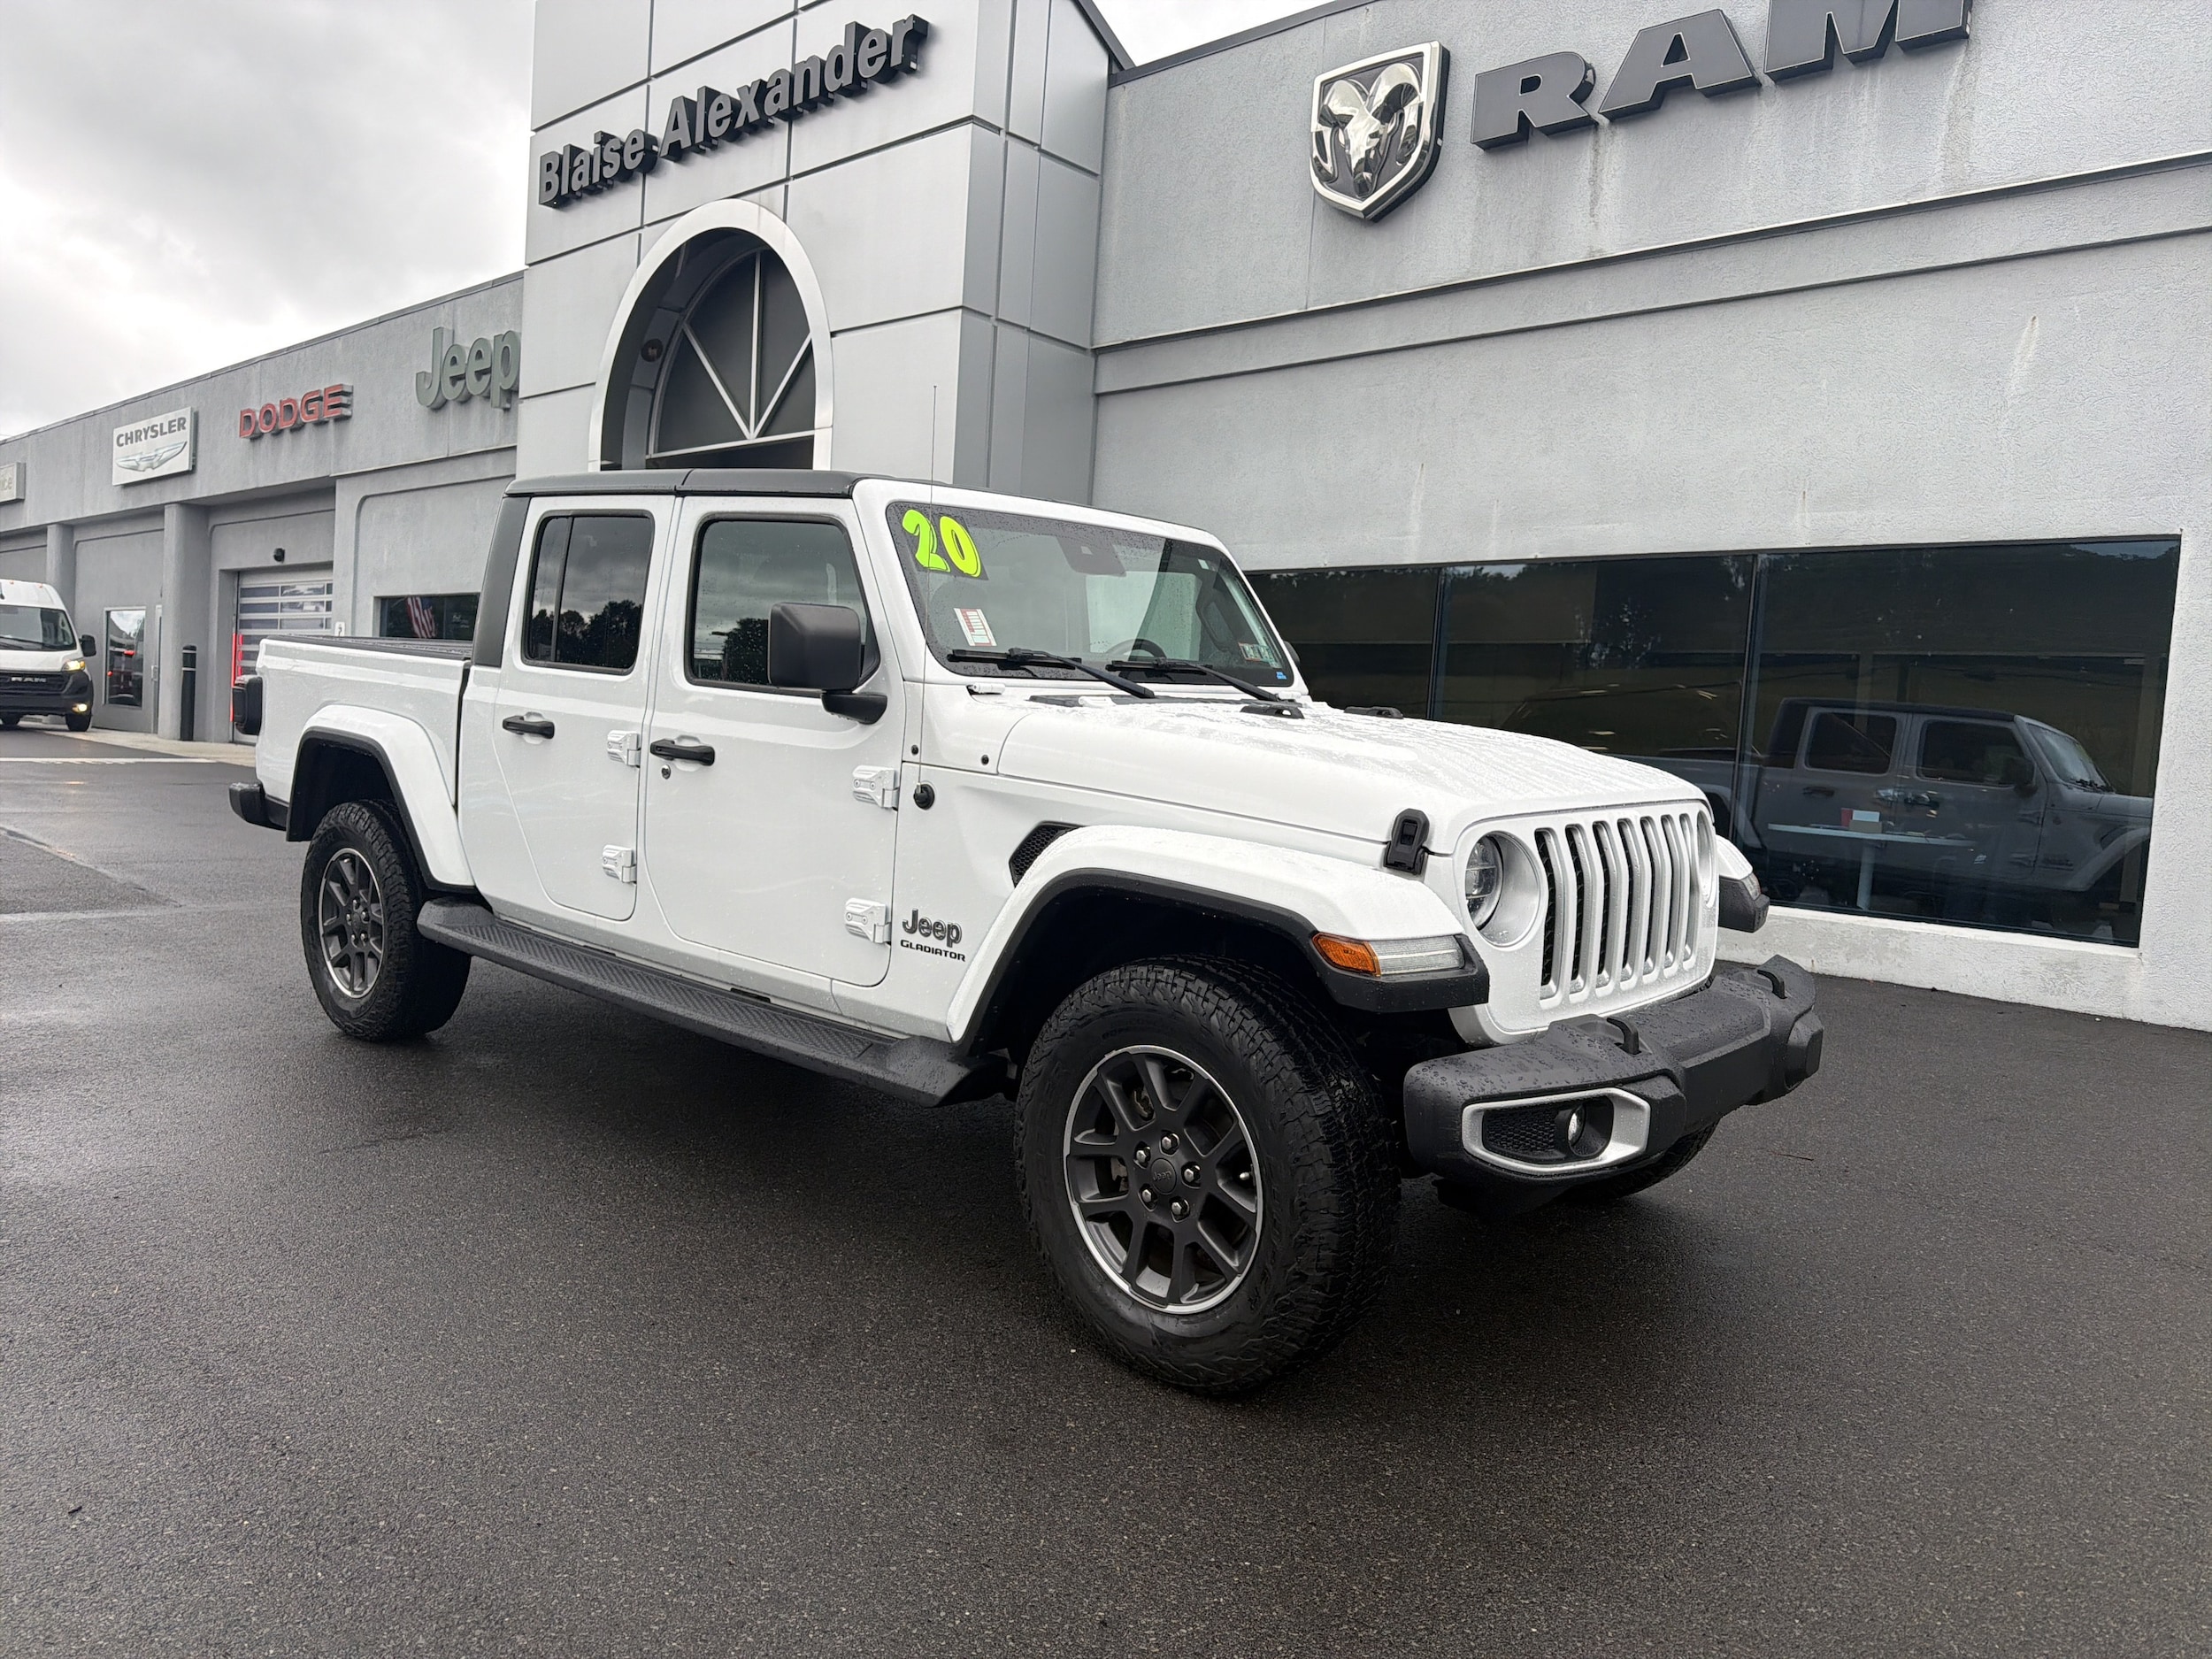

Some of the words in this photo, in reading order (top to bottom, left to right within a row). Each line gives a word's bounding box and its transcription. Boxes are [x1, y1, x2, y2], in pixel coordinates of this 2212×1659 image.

[1470, 0, 1968, 150] RAM
[539, 128, 653, 206] Blaise
[659, 13, 926, 161] Alexander
[415, 326, 520, 408] Jeep
[116, 417, 187, 447] CHRYSLER
[239, 384, 349, 438] DODGE
[902, 509, 981, 578] 20
[900, 939, 965, 962] GLADIATOR
[902, 908, 963, 948] Jeep
